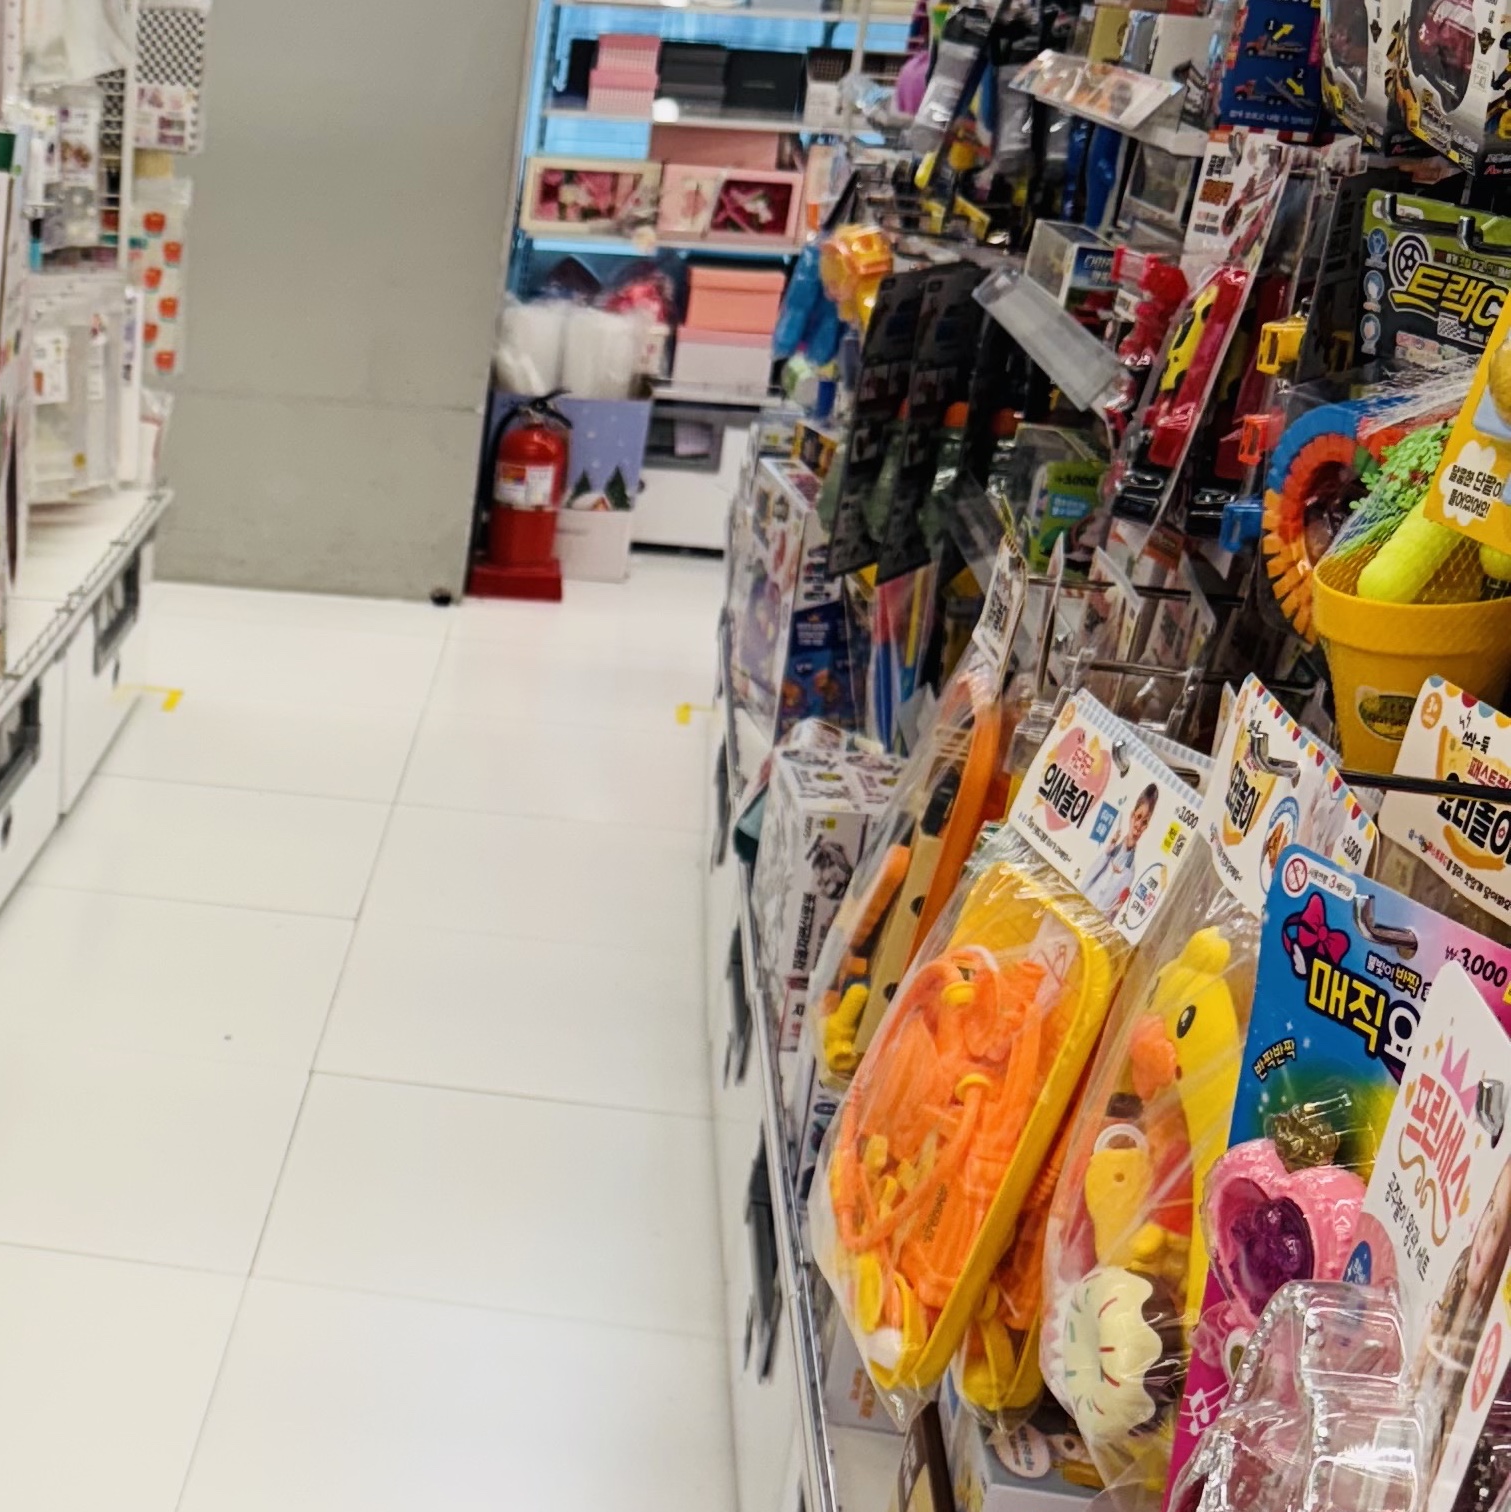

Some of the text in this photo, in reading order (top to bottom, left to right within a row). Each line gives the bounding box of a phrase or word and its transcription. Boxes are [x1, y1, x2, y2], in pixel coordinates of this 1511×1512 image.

[1038, 763, 1094, 829] 의사놀이
[1328, 873, 1338, 890] 3
[1394, 965, 1421, 996] 반짝
[1254, 1039, 1297, 1081] 반짝반짝
[1404, 1072, 1471, 1226] 프린세스
